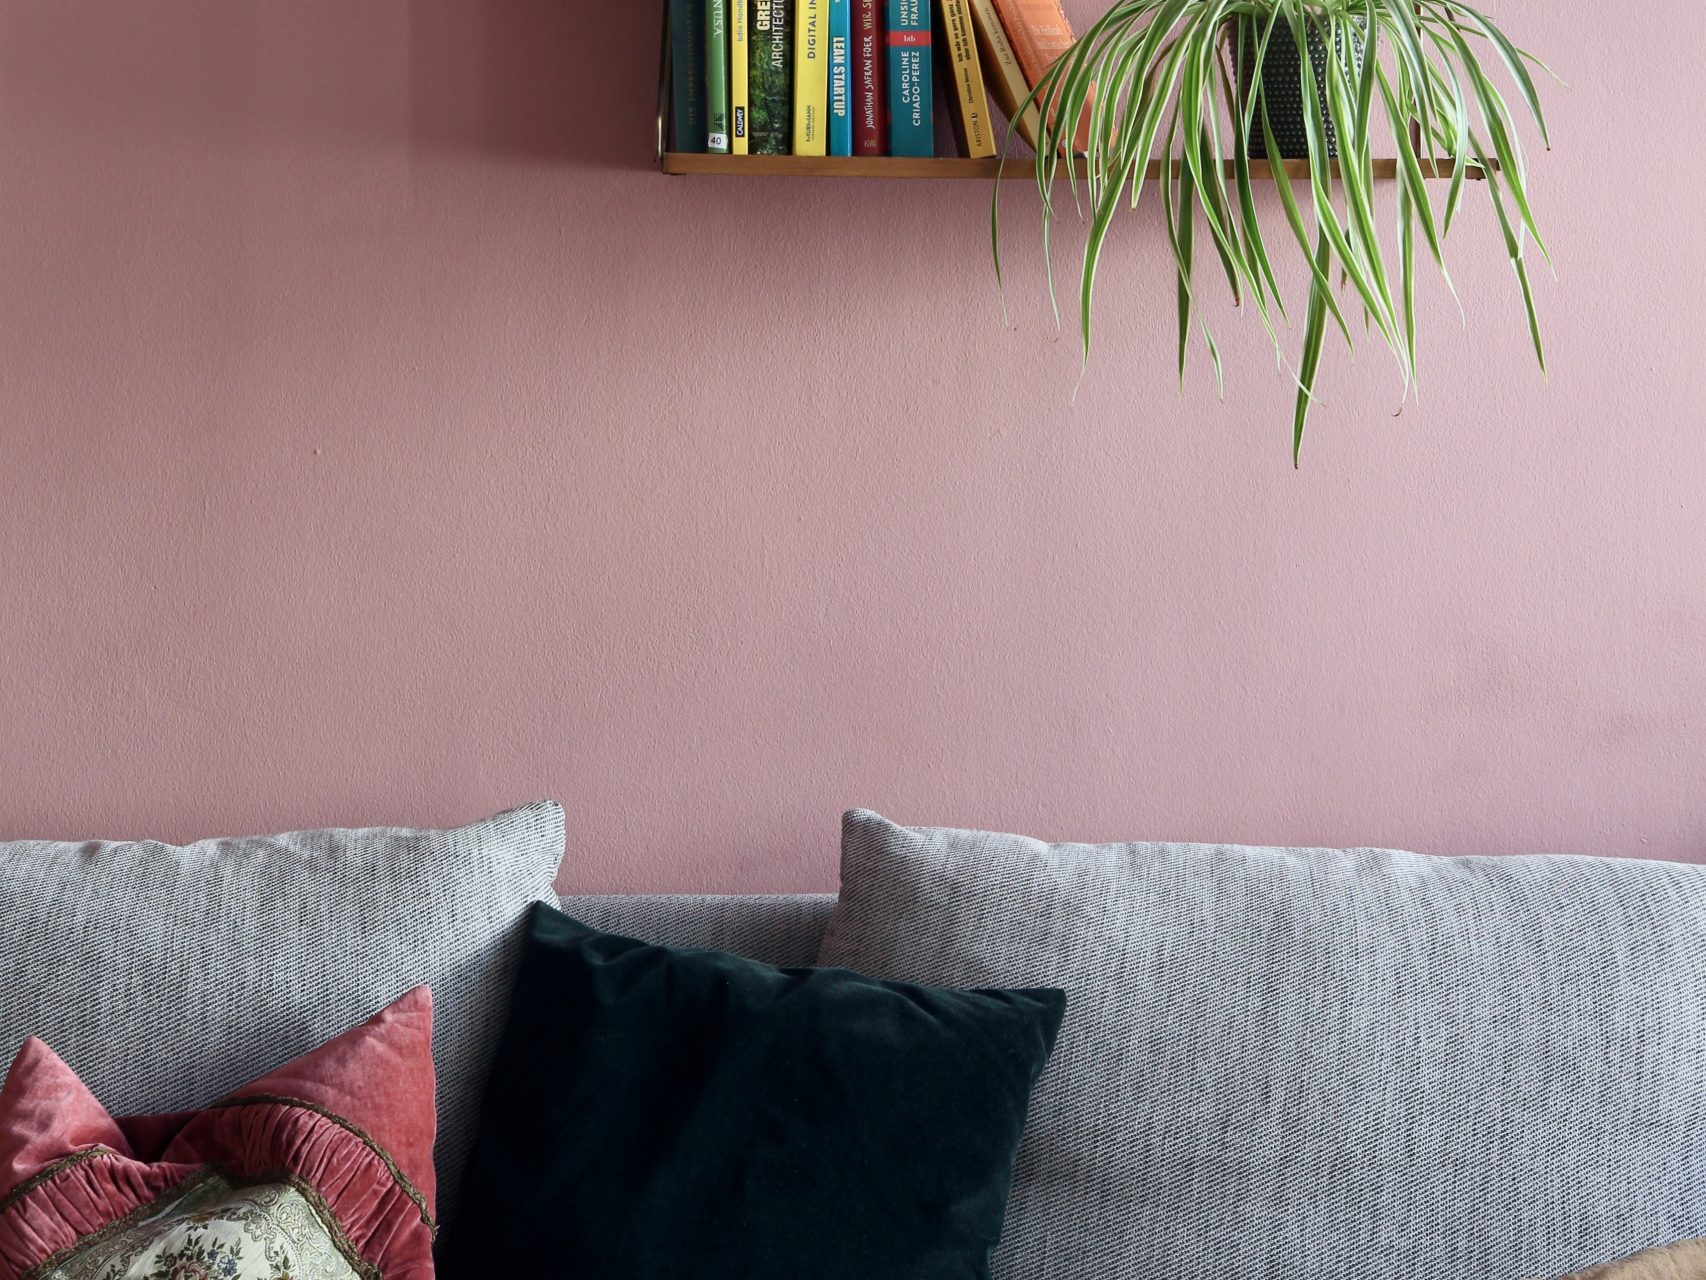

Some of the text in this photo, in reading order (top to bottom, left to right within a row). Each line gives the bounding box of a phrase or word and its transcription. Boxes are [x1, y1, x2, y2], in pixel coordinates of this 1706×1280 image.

[863, 11, 873, 30] WIR
[948, 3, 956, 18] ganz
[807, 14, 817, 60] DIGITAL
[951, 18, 959, 32] gern
[953, 32, 959, 40] so
[958, 15, 967, 37] komme
[984, 7, 1012, 66] Zur Ruhe kommen
[863, 35, 873, 57] FOER
[833, 36, 846, 117] LEAN STARTUP
[864, 59, 874, 90] SAFRAN
[901, 51, 910, 103] CAROLINE
[911, 51, 921, 126] CRIADO-PEREZ
[736, 109, 744, 136] CALLWEY
[865, 91, 875, 129] JONATHAN
[711, 136, 722, 145] 40
[972, 120, 982, 147] ARISTON
